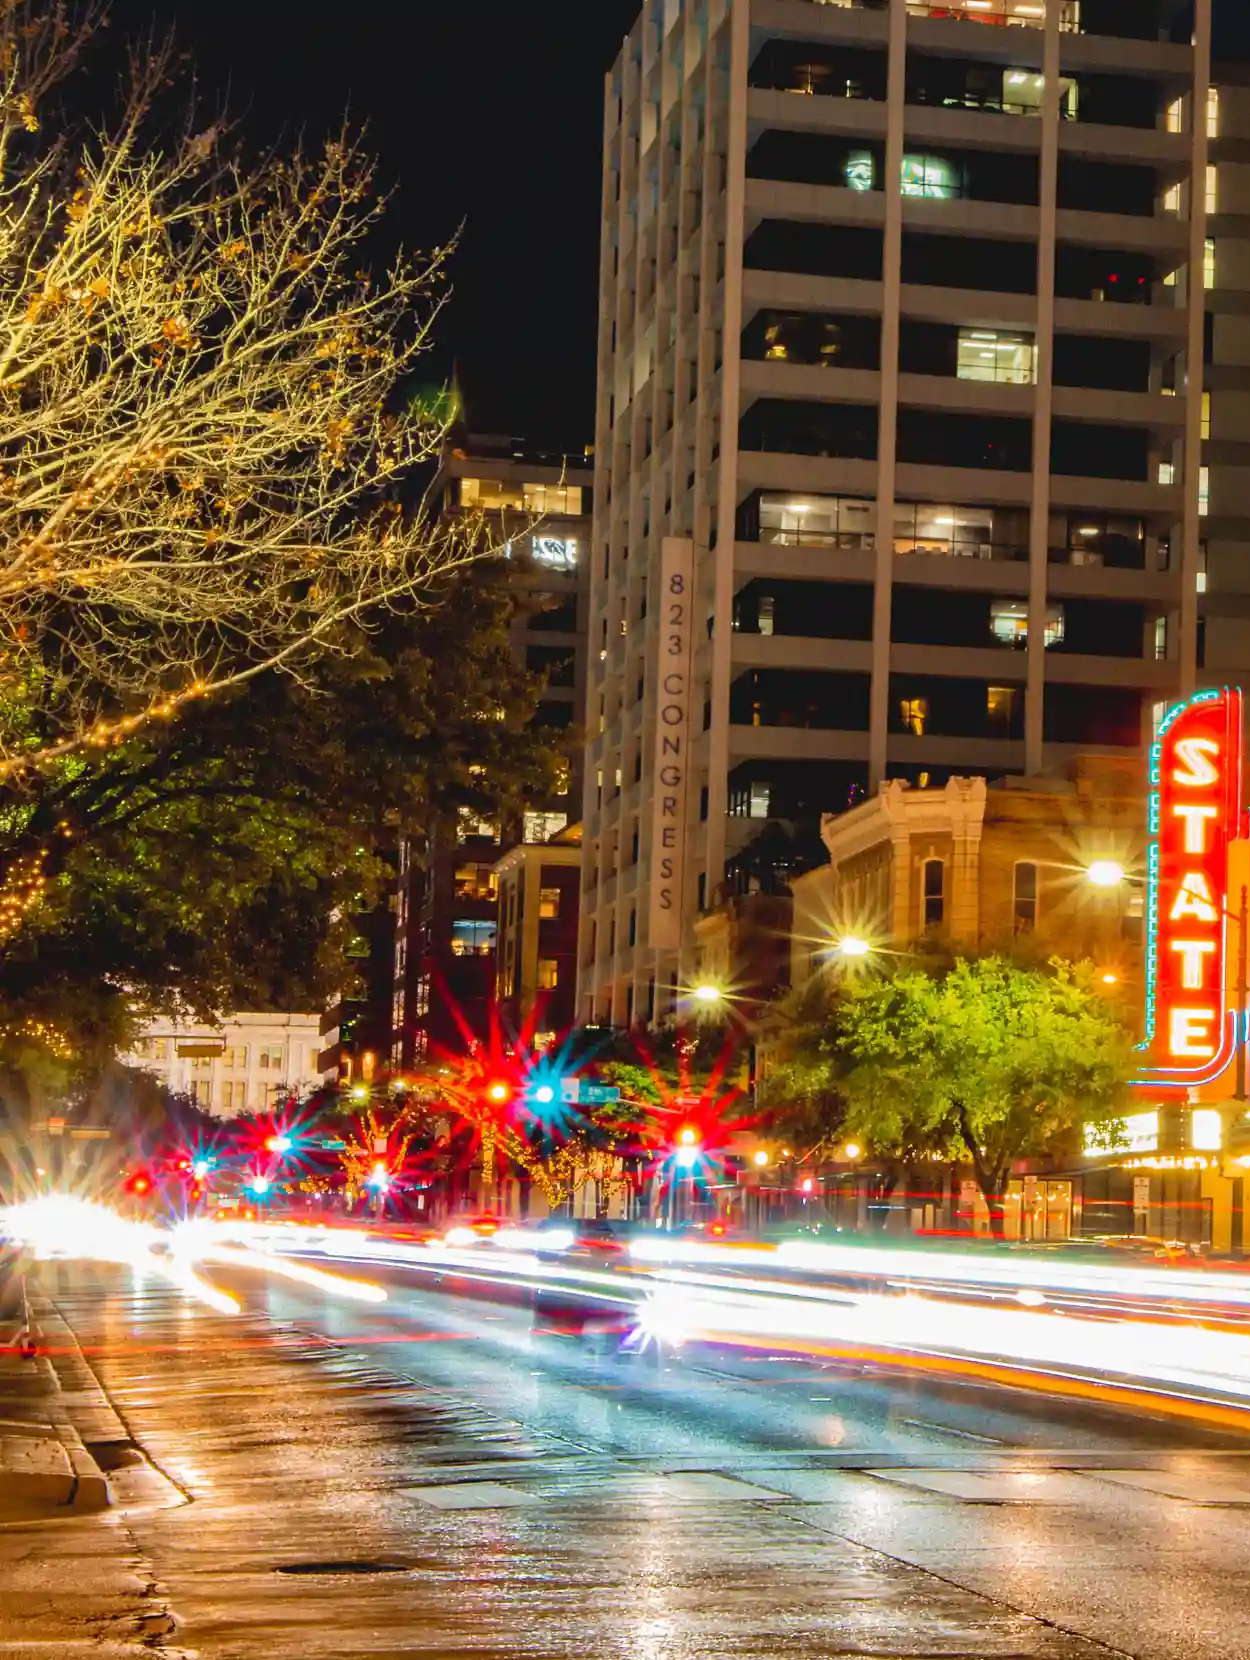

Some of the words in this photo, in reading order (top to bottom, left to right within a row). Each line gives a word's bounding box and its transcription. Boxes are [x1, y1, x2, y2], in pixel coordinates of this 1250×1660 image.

[668, 574, 684, 656] 823
[659, 673, 684, 910] CONGRESS
[1169, 738, 1220, 1057] STATE
